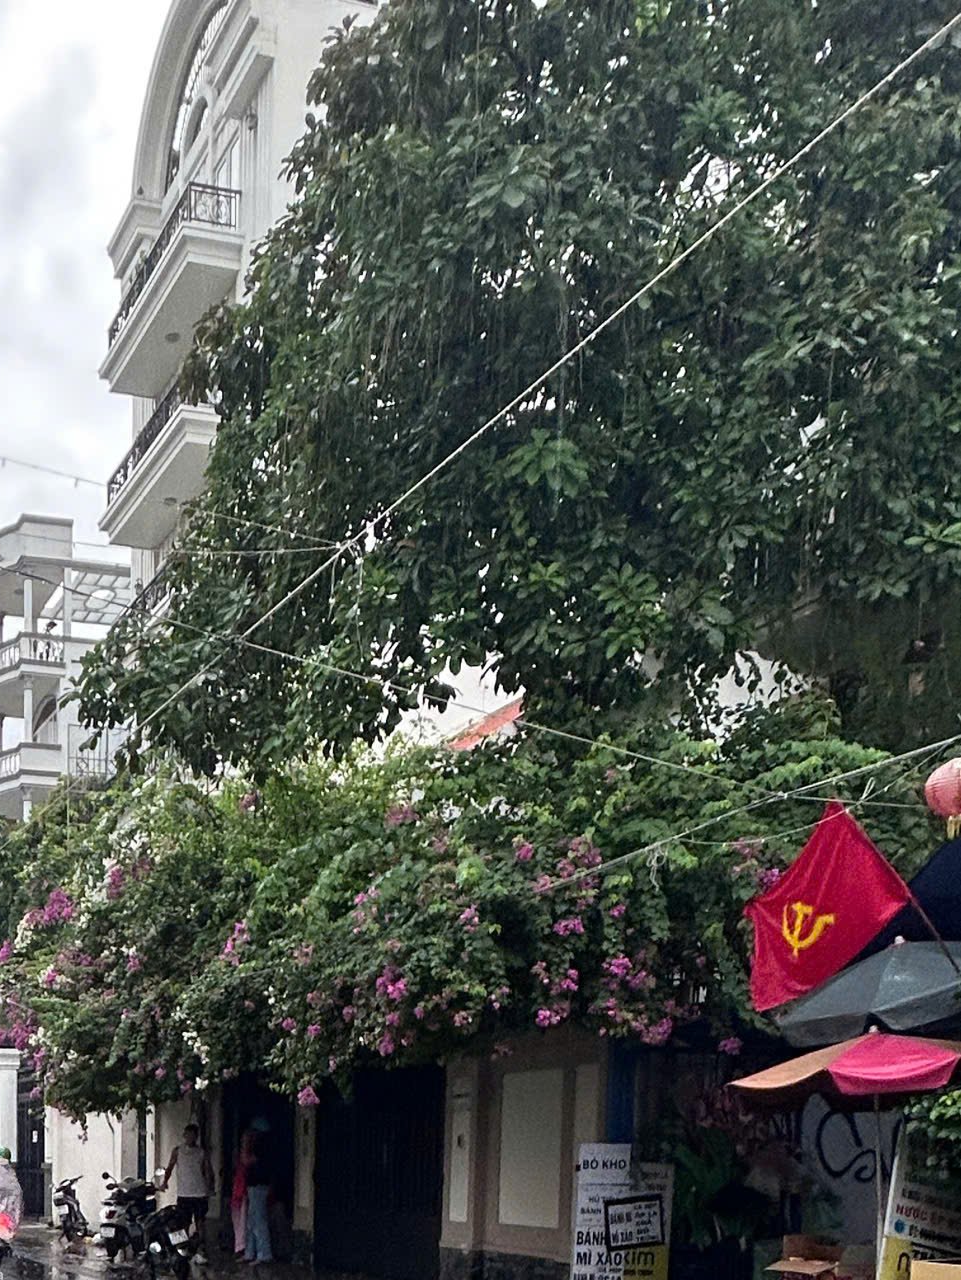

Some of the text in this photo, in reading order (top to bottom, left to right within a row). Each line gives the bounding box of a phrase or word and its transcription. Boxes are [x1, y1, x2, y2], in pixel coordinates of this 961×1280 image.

[602, 1159, 627, 1170] KHO
[576, 1228, 607, 1246] BÁNH
[576, 1249, 592, 1266] MÌ
